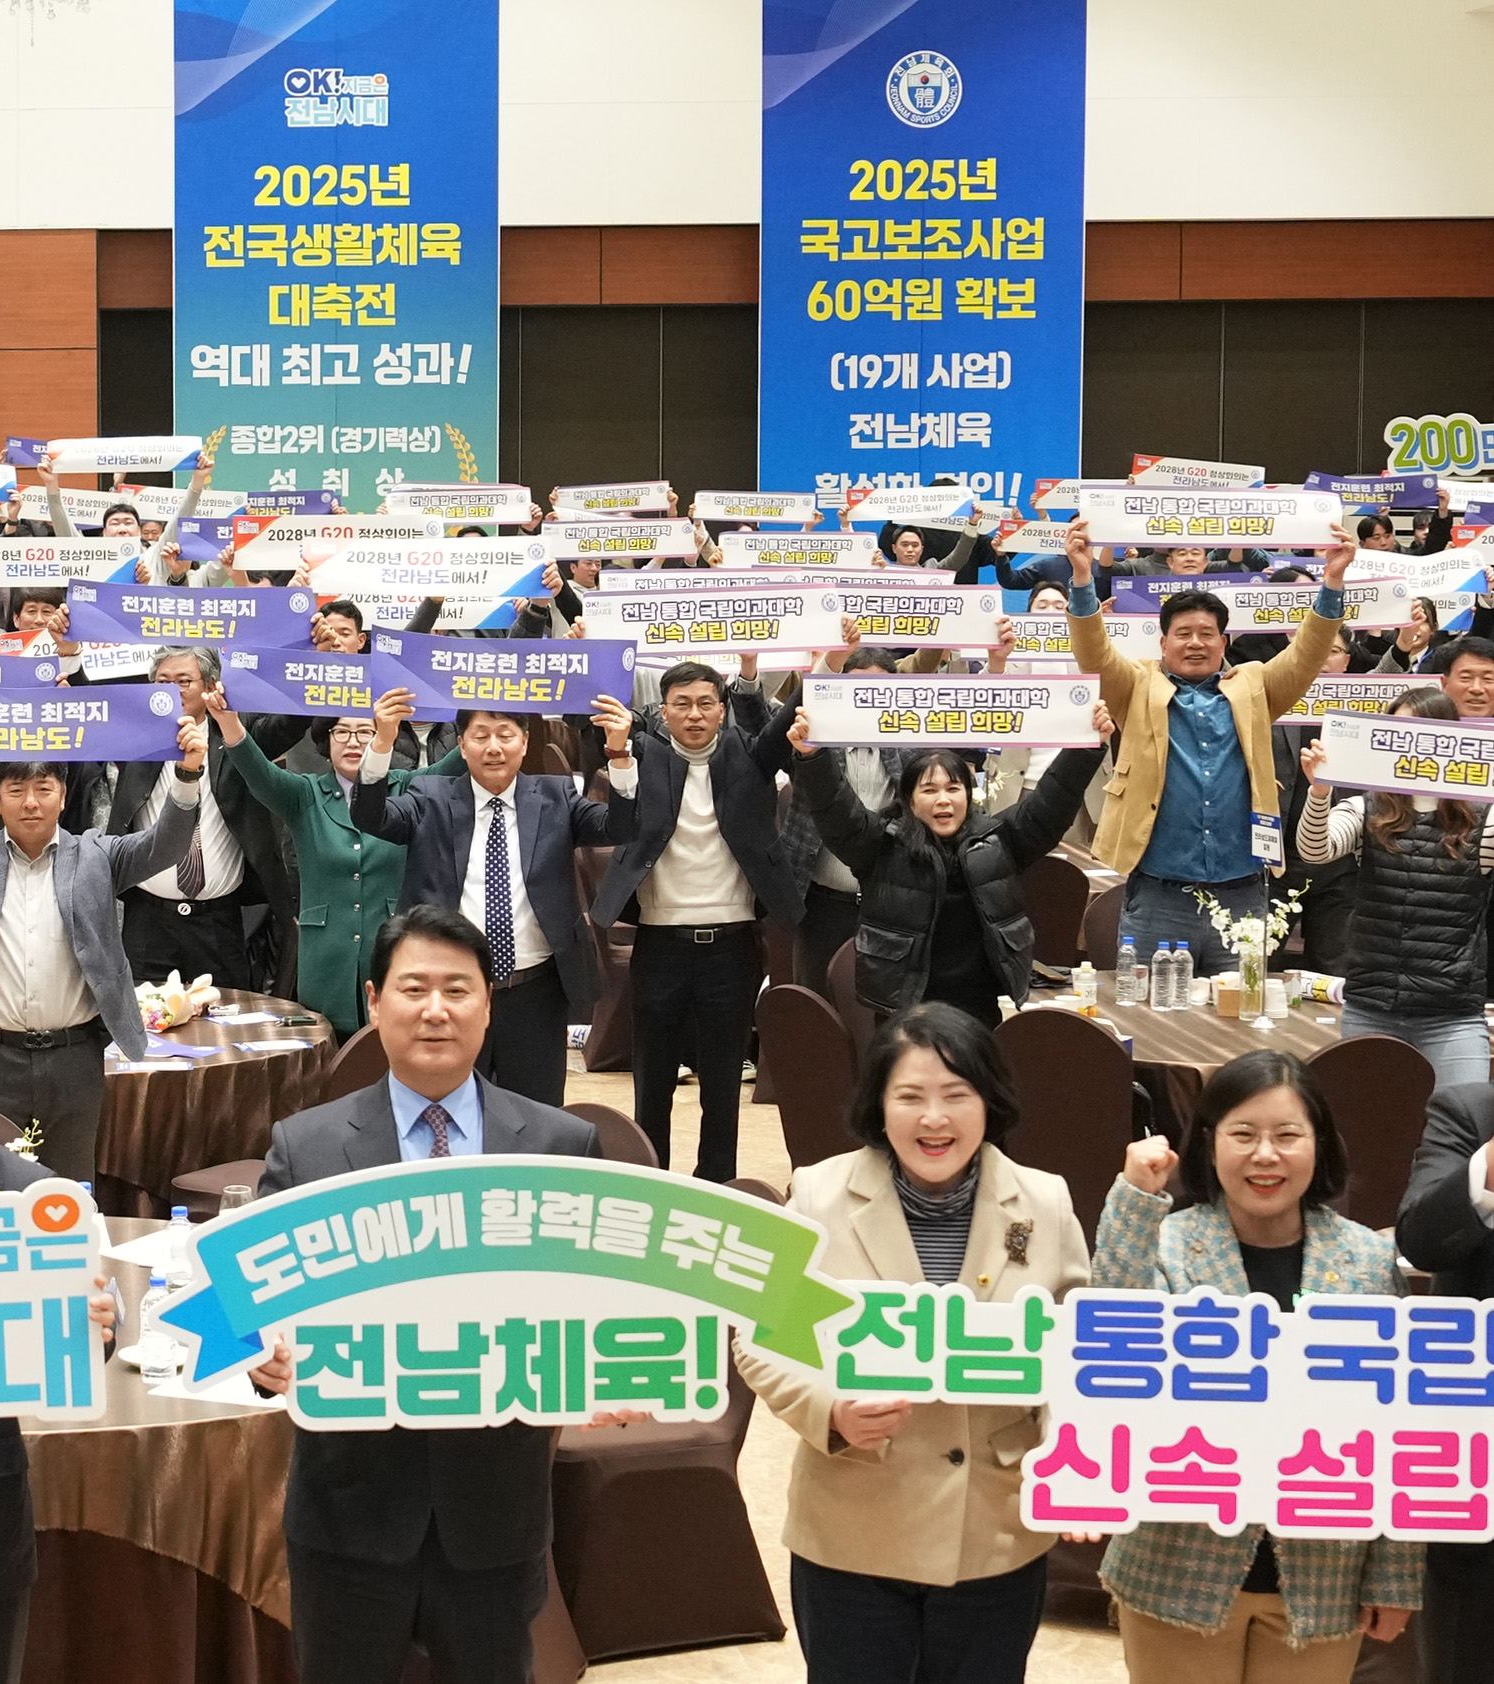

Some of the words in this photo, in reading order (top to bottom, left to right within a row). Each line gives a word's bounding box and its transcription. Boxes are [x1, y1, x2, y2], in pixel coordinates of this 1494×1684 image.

[285, 69, 344, 96] OK!
[343, 74, 388, 95] 지금은
[285, 97, 388, 127] 전남시대
[910, 113, 941, 124] SPORTS
[254, 163, 410, 206] 2025년
[850, 158, 996, 200] 2025년
[204, 223, 461, 267] 전국생활체육
[800, 217, 1044, 262] 국고보조사업
[269, 283, 396, 326] 대축전
[807, 278, 942, 321] 60억원
[956, 278, 1036, 320] 확보
[191, 343, 270, 386] 역대
[282, 343, 361, 385] 최고
[373, 343, 472, 385] 성과!
[831, 352, 918, 390] (19개
[927, 351, 1011, 390] 사업)
[230, 425, 324, 454] 종합2위
[331, 424, 441, 454] (경기력상)
[850, 413, 991, 449] 전남체육
[1330, 482, 1371, 493] 전지훈련
[1373, 482, 1405, 493] 최적지
[1341, 492, 1394, 503] 전라남도!
[1128, 497, 1158, 514] 전남
[1161, 498, 1197, 515] 통합
[1199, 497, 1297, 515] 국립의과대학
[1146, 517, 1182, 535] 신속
[1187, 517, 1224, 535] 설립
[1227, 516, 1274, 535] 희망!
[25, 548, 54, 562] G20
[59, 548, 118, 561] 정상회의는
[577, 540, 600, 553] 신속
[603, 539, 626, 551] 설립
[628, 538, 656, 550] 희망!
[6, 563, 90, 578] 전라남도에서!
[121, 595, 196, 615] 전지훈련
[200, 598, 256, 618] 최적지
[621, 603, 659, 622] 전남
[660, 602, 697, 621] 통합
[699, 595, 804, 619] 국립의과대학
[140, 617, 236, 639] 전라남도!
[646, 622, 683, 644] 신속
[688, 621, 727, 642] 설립
[732, 619, 779, 640] 희망!
[430, 650, 520, 675] 전지훈련
[524, 651, 589, 675] 최적지
[451, 676, 566, 702] 전라남도!
[854, 687, 894, 709] 전남
[896, 687, 934, 708] 통합
[937, 687, 1049, 709] 국립의과대학
[40, 701, 109, 723] 최적지
[879, 711, 920, 733] 신속
[925, 711, 966, 733] 설립
[970, 711, 1023, 733] 희망!
[1370, 728, 1413, 752] 전남
[1416, 731, 1457, 756] 통합
[1393, 755, 1439, 782] 신속
[1443, 760, 1489, 787] 설립
[235, 1191, 467, 1304] 도민에게
[480, 1187, 654, 1259] 활력을
[660, 1208, 775, 1292] 주는
[837, 1292, 1054, 1395] 전남
[1073, 1296, 1280, 1404] 통합
[297, 1315, 719, 1418] 전남체육!
[1032, 1422, 1242, 1526] 신속
[1277, 1427, 1489, 1531] 설립
